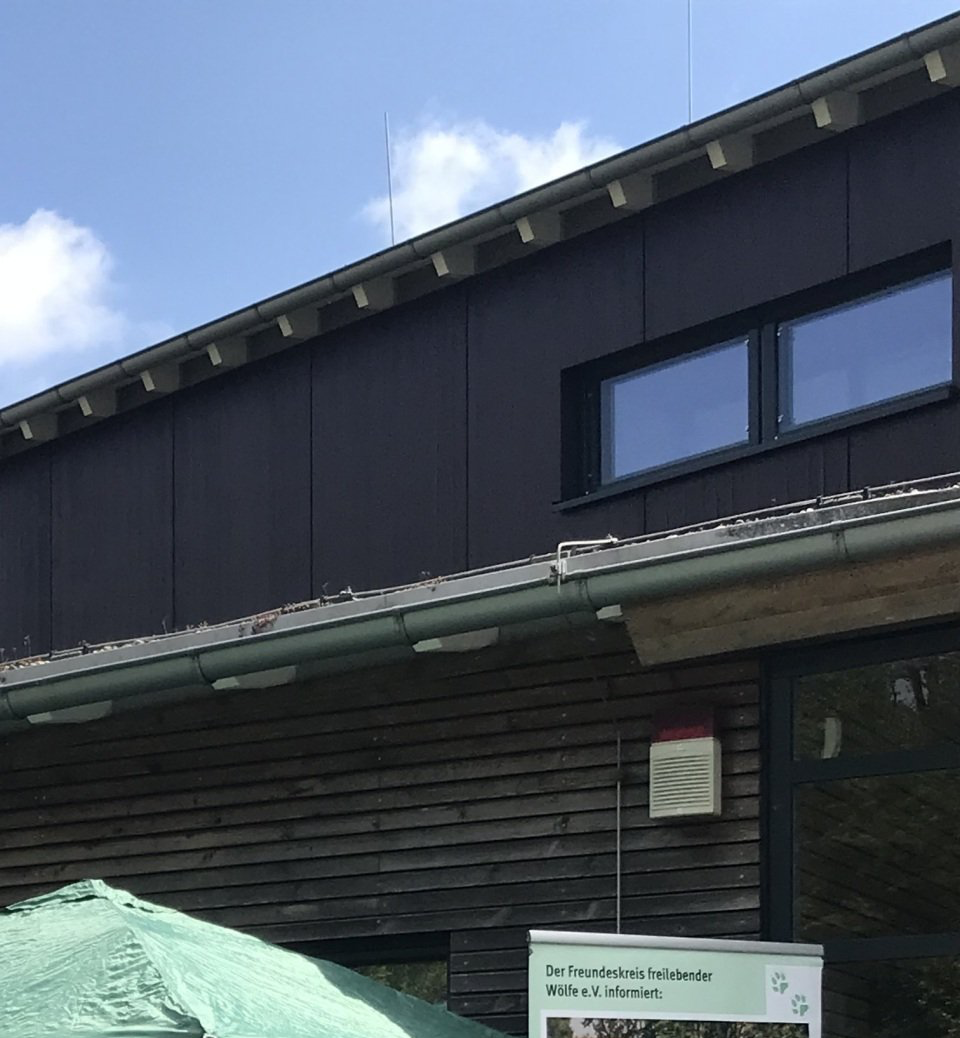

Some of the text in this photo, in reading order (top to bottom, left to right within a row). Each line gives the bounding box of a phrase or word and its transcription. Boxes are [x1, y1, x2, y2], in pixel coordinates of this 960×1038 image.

[546, 965, 712, 982] Der Freundeskreis freilebender
[546, 984, 663, 1000] Wölfe e.V. informiert:
